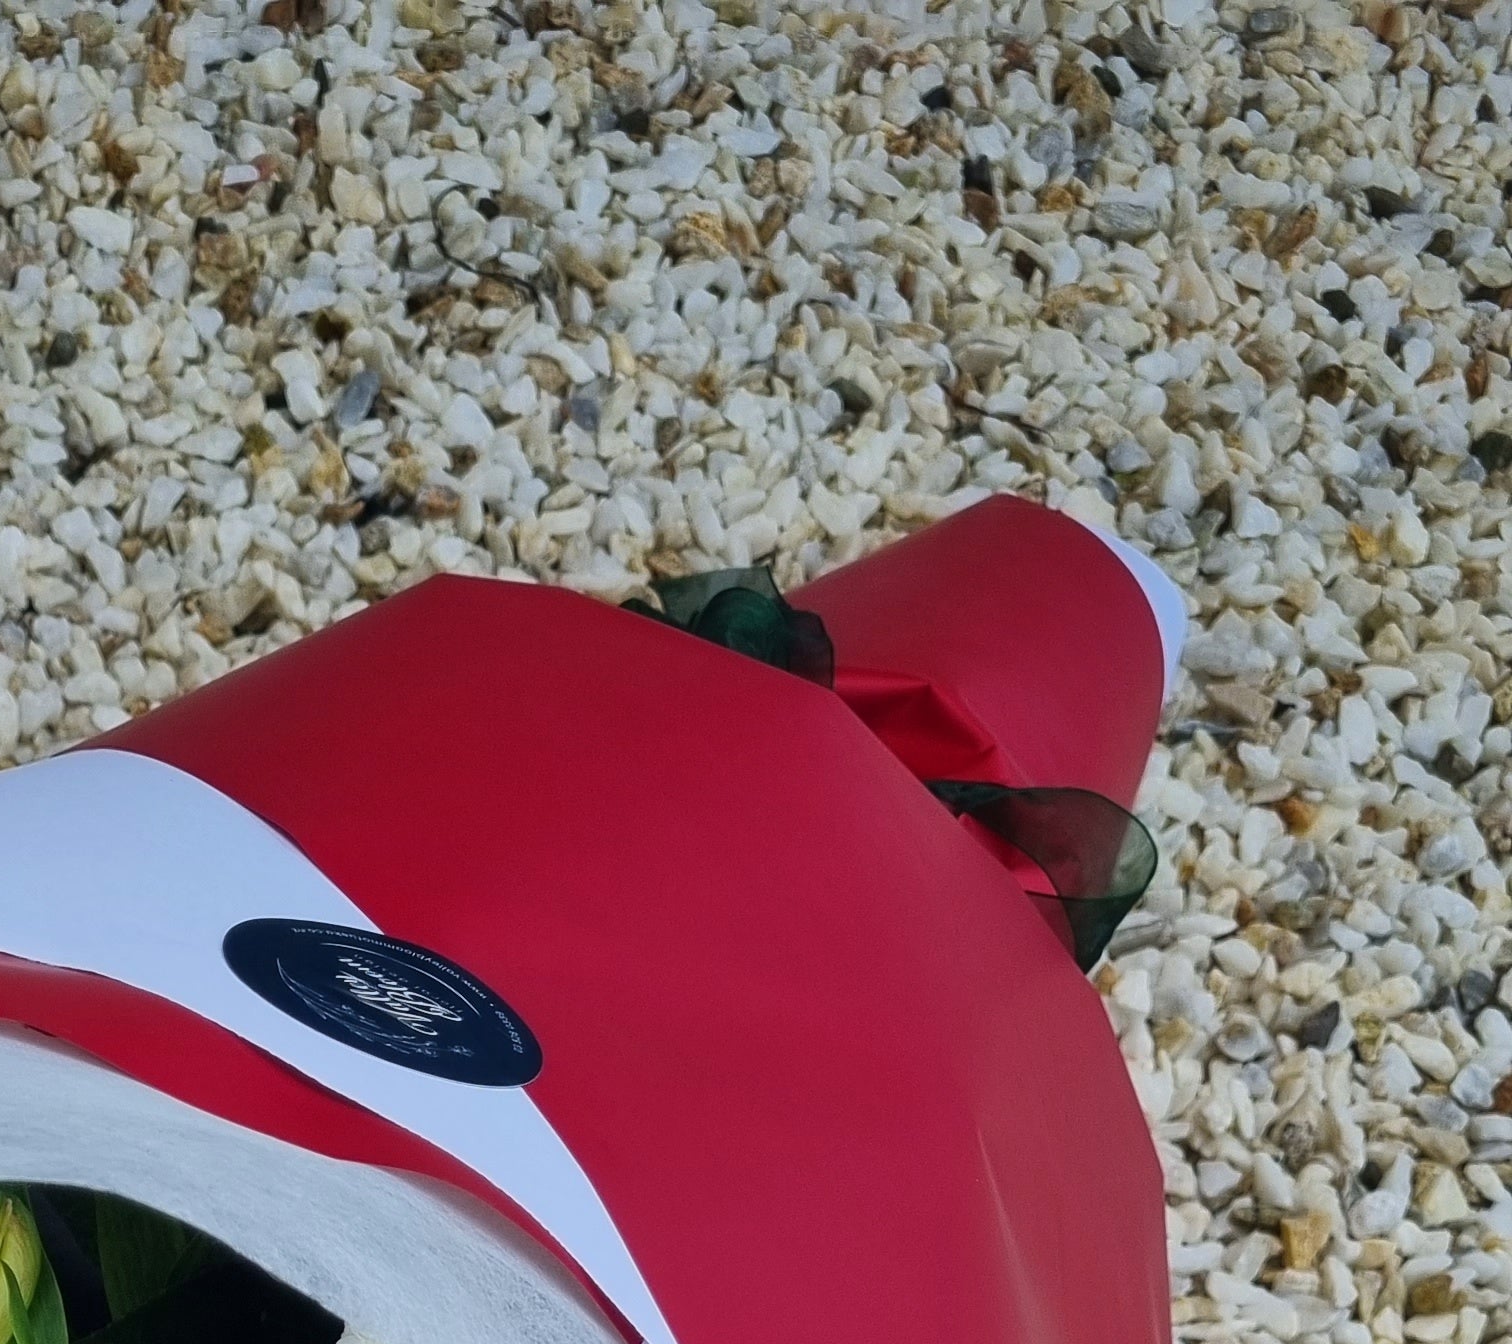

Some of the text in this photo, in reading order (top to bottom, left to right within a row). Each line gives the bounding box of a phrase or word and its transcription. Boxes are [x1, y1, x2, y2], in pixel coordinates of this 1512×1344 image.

[338, 956, 463, 1022] Bloom
[353, 953, 409, 984] design
[335, 970, 438, 1036] Valley
